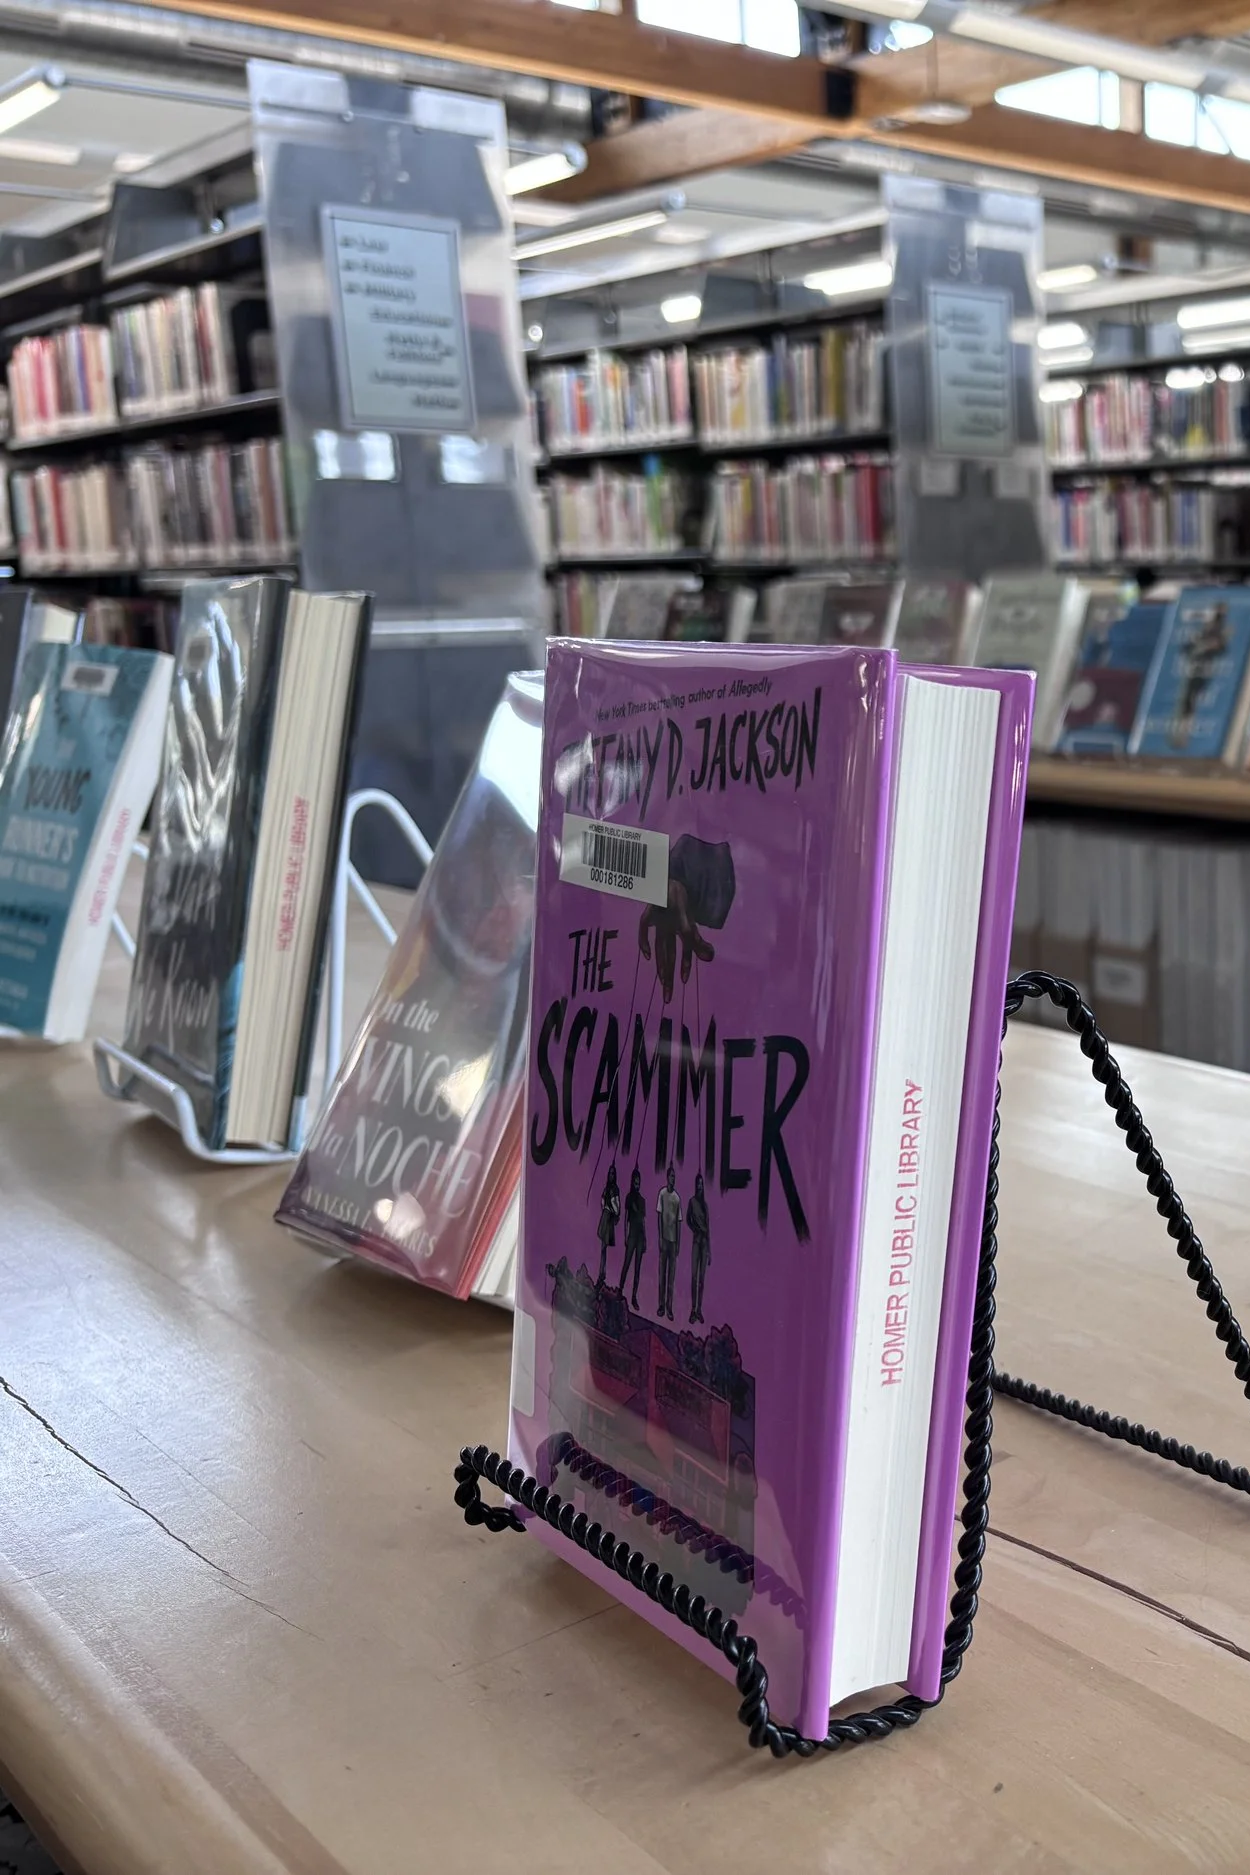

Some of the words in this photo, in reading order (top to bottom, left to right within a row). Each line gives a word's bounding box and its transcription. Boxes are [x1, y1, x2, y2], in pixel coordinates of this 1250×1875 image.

[611, 705, 626, 719] York
[627, 701, 647, 716] Times
[688, 687, 715, 704] author
[717, 684, 727, 700] of
[728, 675, 772, 698] Allegedly
[667, 717, 684, 802] D.
[690, 686, 822, 795] JACKSON
[590, 867, 634, 891] 000181286
[604, 826, 621, 838] PUBLIC
[621, 829, 642, 841] LIBRARY
[568, 927, 619, 998] THE
[335, 1115, 482, 1218] NOCHE
[530, 997, 812, 1246] SCAMMER
[897, 1078, 924, 1190] LIBRARY
[888, 1195, 918, 1288] PUBLIC
[880, 1290, 909, 1387] HOMER
